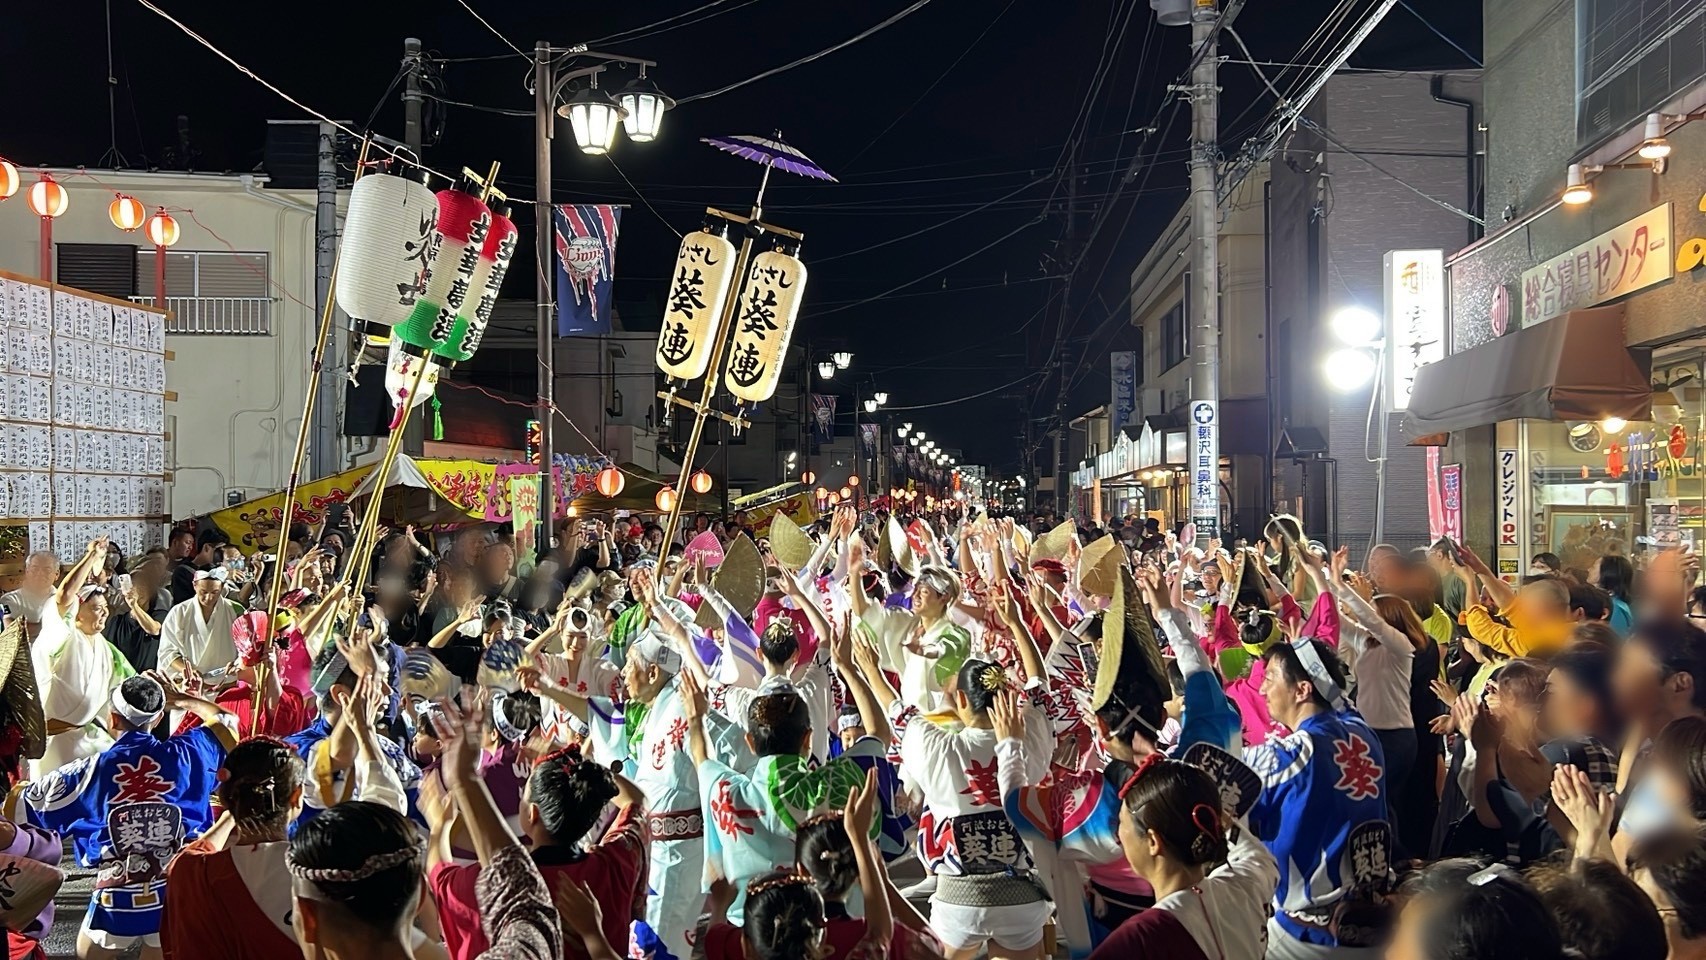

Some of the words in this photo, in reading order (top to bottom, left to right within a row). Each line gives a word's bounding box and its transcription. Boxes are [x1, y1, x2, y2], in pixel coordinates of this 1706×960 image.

[680, 242, 720, 267] むさし
[1525, 224, 1666, 324] 総合寝具センター
[752, 261, 794, 289] むさし
[657, 266, 707, 367] 葵連
[728, 286, 779, 388] 葵連
[1332, 732, 1384, 801] 葵
[116, 817, 178, 851] 葵連
[118, 807, 172, 823] 阿波おどり
[959, 830, 1019, 866] 葵連
[1352, 841, 1389, 885] 葵連
